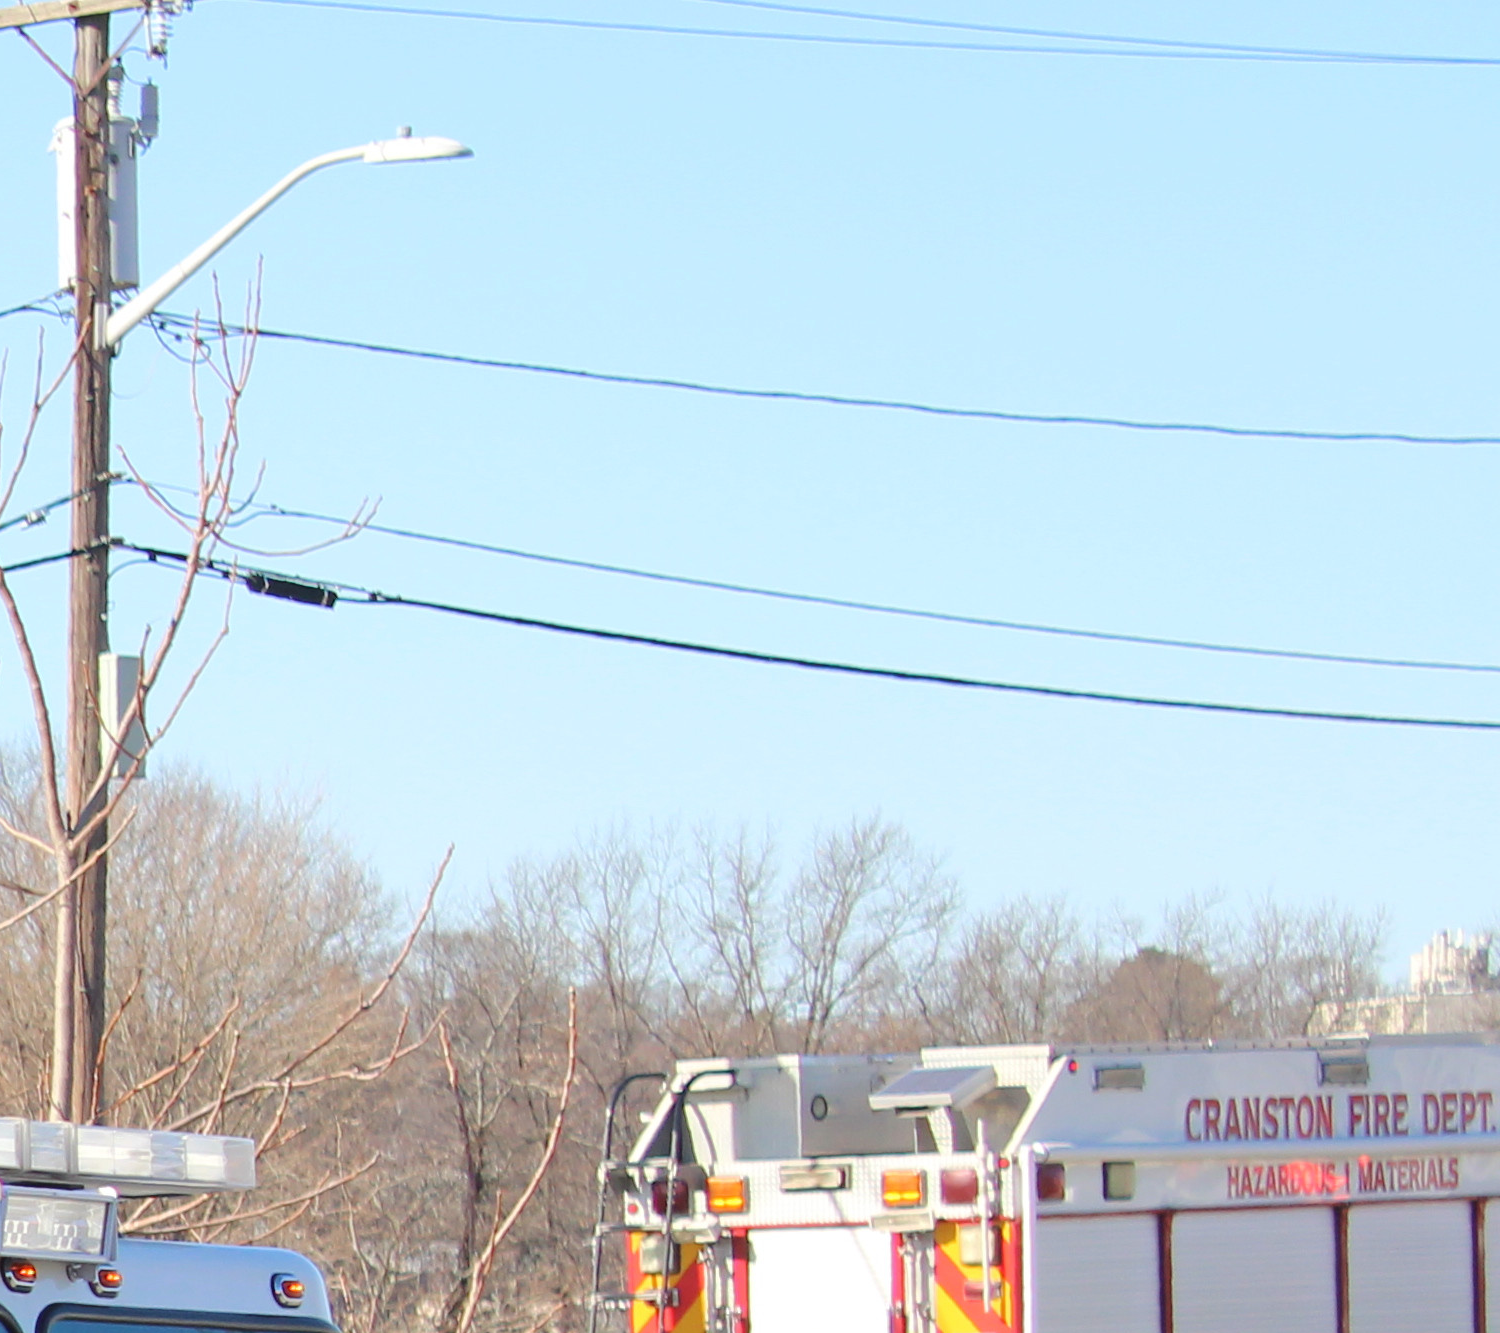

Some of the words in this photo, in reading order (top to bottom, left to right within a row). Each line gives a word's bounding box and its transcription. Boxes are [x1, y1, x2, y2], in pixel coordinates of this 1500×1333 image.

[1185, 1095, 1333, 1142] CRANSTON
[1349, 1093, 1409, 1137] FIRE
[1422, 1091, 1496, 1135] DEPT.
[1227, 1162, 1336, 1199] HAZARDOUS
[1359, 1158, 1459, 1193] MATERIALS
